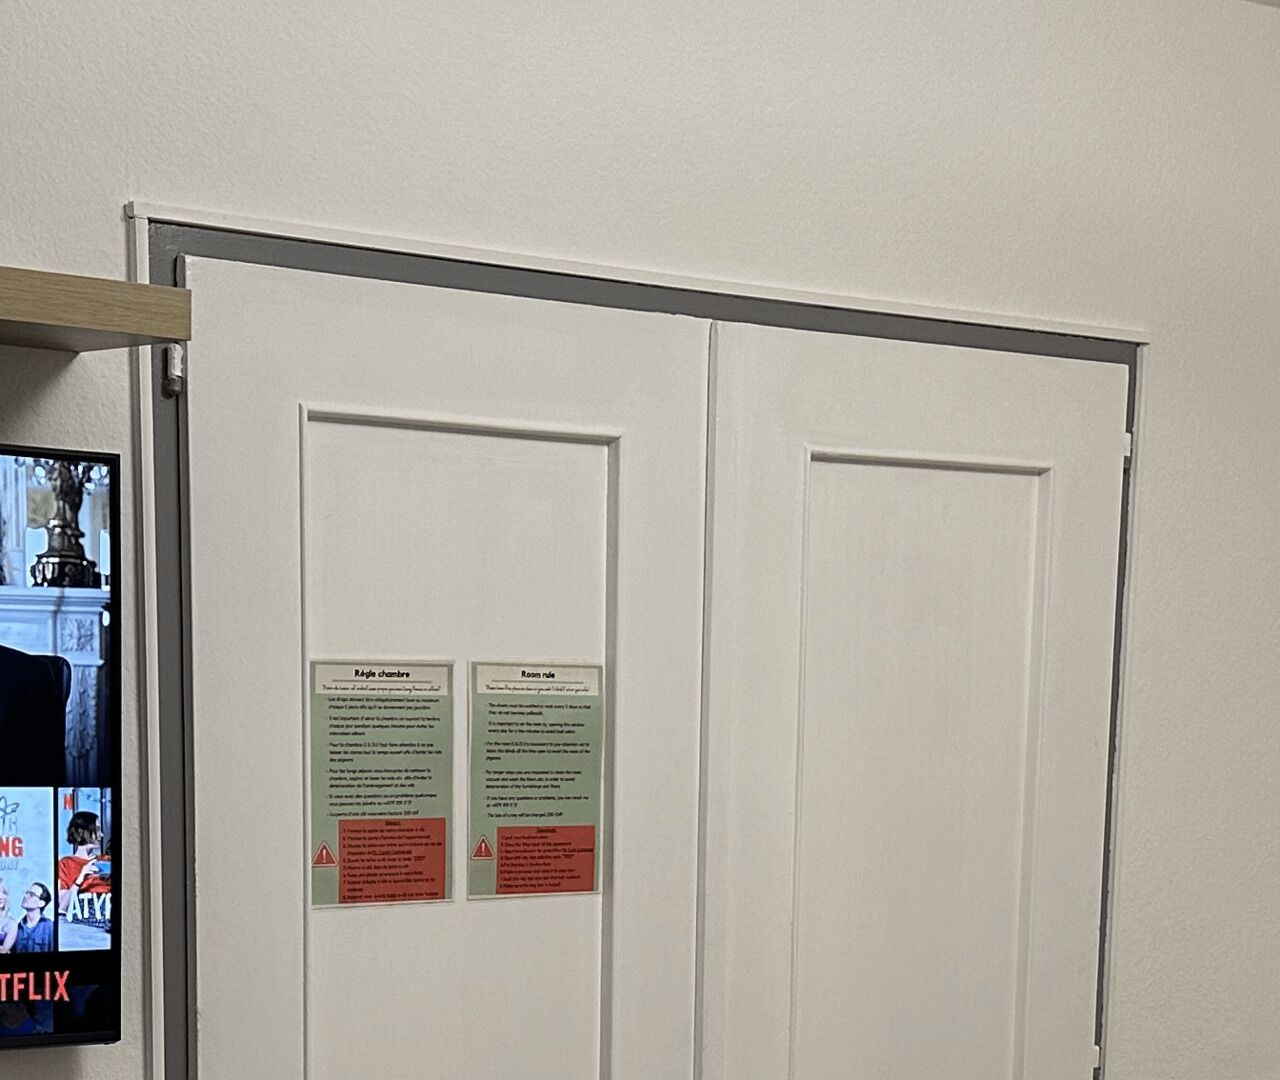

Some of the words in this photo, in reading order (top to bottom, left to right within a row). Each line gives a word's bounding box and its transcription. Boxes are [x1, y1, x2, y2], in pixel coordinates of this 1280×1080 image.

[378, 669, 410, 678] chambre
[521, 670, 541, 679] Room
[542, 670, 555, 679] rule
